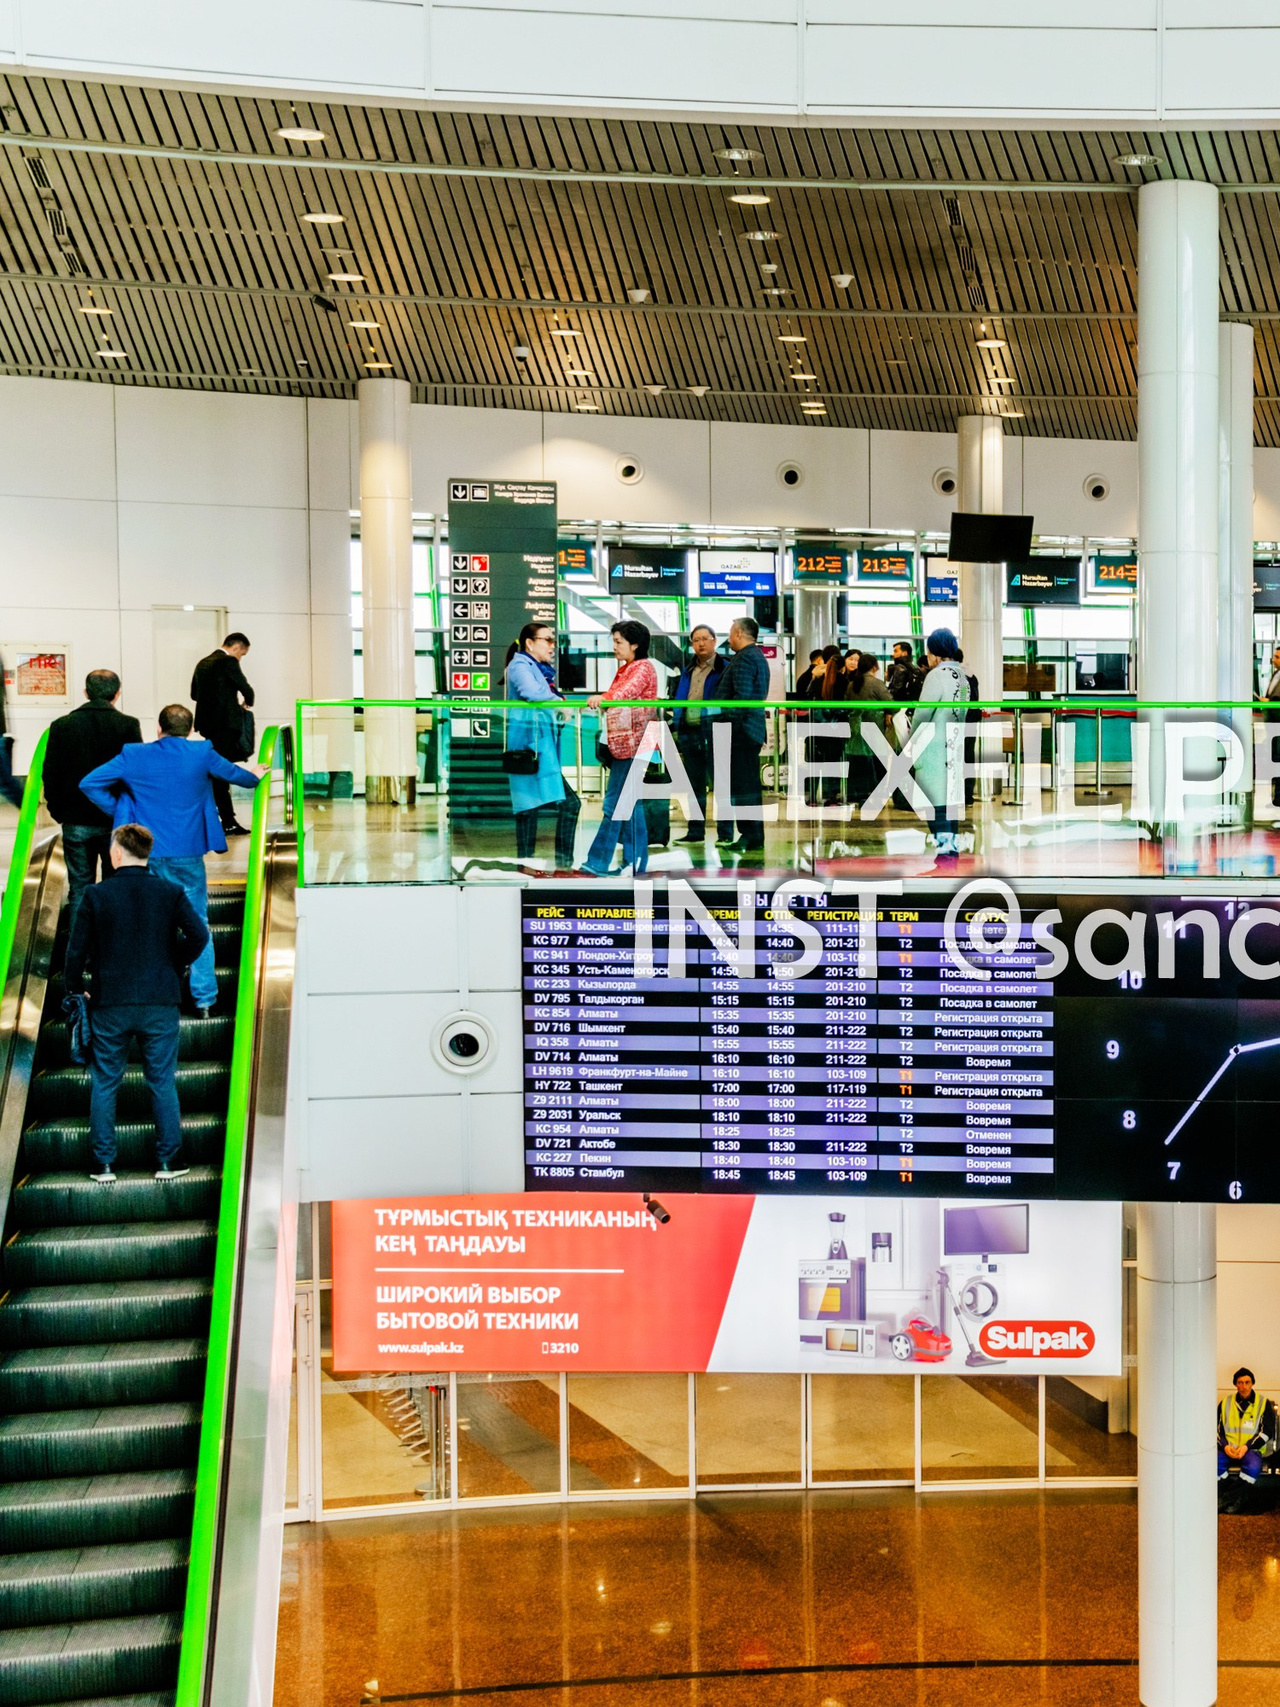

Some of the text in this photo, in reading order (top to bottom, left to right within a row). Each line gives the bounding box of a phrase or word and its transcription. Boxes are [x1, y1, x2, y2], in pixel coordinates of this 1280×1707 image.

[798, 557, 826, 571] 212
[862, 558, 890, 572] 213
[1099, 565, 1125, 579] 214
[743, 894, 828, 907] ВЫЛЕТЫ
[537, 908, 918, 922] РЕЙС НАПРАВЛЕНИЕ РЕГИСТРАЦИЯ ТЕРМ
[552, 980, 570, 989] 233
[578, 980, 636, 990] Кызылорда
[712, 982, 739, 991] 14:55
[767, 982, 794, 992] 14:55
[826, 982, 866, 992] 201-210
[940, 983, 982, 994] Посадка
[1118, 970, 1143, 989] 10
[535, 1023, 550, 1032] DV
[552, 1023, 570, 1032] 716
[578, 1024, 625, 1033] Шымкент
[712, 1025, 739, 1034] 15:40
[768, 1026, 794, 1035] 15:40
[826, 1026, 866, 1035] 211-222
[935, 1028, 998, 1038] Регистрация
[1001, 1029, 1042, 1038] открыта
[1106, 1040, 1120, 1059] 9
[533, 1066, 548, 1076] LH
[550, 1067, 573, 1076] 9619
[579, 1067, 688, 1078] Франкфурт-на-Майне
[712, 1069, 739, 1078] 16:10
[768, 1069, 794, 1078] 16:10
[826, 1070, 866, 1079] 103-109
[935, 1072, 998, 1082] Регистрация
[1001, 1073, 1042, 1082] открыта
[1123, 1111, 1136, 1129] 8
[553, 1124, 571, 1134] 954
[580, 1125, 619, 1134] Алматы
[713, 1127, 740, 1136] 18:25
[768, 1127, 795, 1136] 18:25
[966, 1130, 1011, 1140] Отменен
[550, 1168, 574, 1178] 8805
[580, 1168, 624, 1178] Стамбул
[713, 1170, 740, 1180] 18:45
[768, 1170, 795, 1180] 18:45
[827, 1172, 867, 1181] 103-109
[966, 1174, 1011, 1184] Вовремя
[1167, 1162, 1181, 1180] 7
[1229, 1181, 1242, 1200] 6
[375, 1209, 657, 1232] ТҰРМЫСТЫҚ ТЕХНИКАНЫҢ
[375, 1235, 526, 1256] КЕҢ ТАҢДАУЫ
[376, 1284, 561, 1304] ШИРОКИЙ ВЫБОР
[376, 1310, 579, 1330] БЫТОВОЙ ТЕХНИКИ
[987, 1326, 1088, 1355] Sulpak
[378, 1342, 579, 1356] www.sulpak.kz 3210
